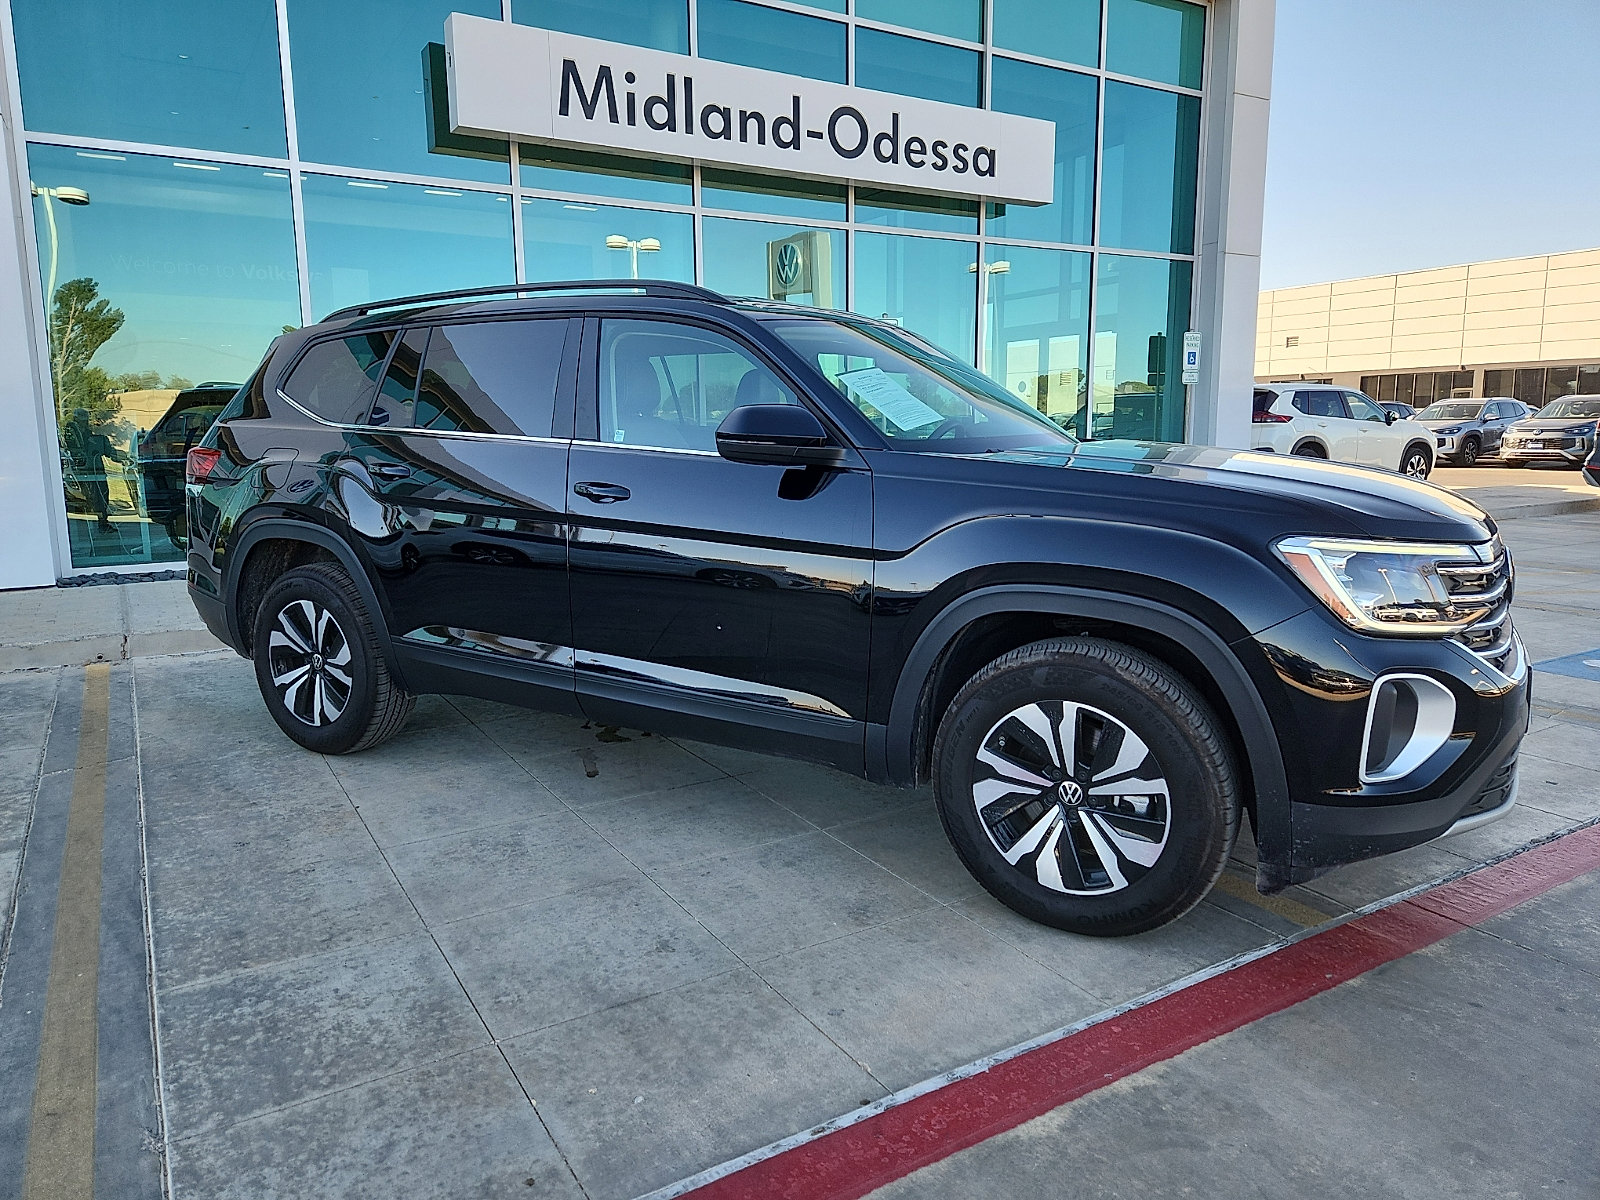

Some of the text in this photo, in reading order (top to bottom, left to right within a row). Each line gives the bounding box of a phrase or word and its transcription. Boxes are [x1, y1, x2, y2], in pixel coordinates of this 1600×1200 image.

[558, 58, 997, 178] Midland-Odessa
[109, 254, 210, 275] Welcome
[216, 263, 234, 279] to
